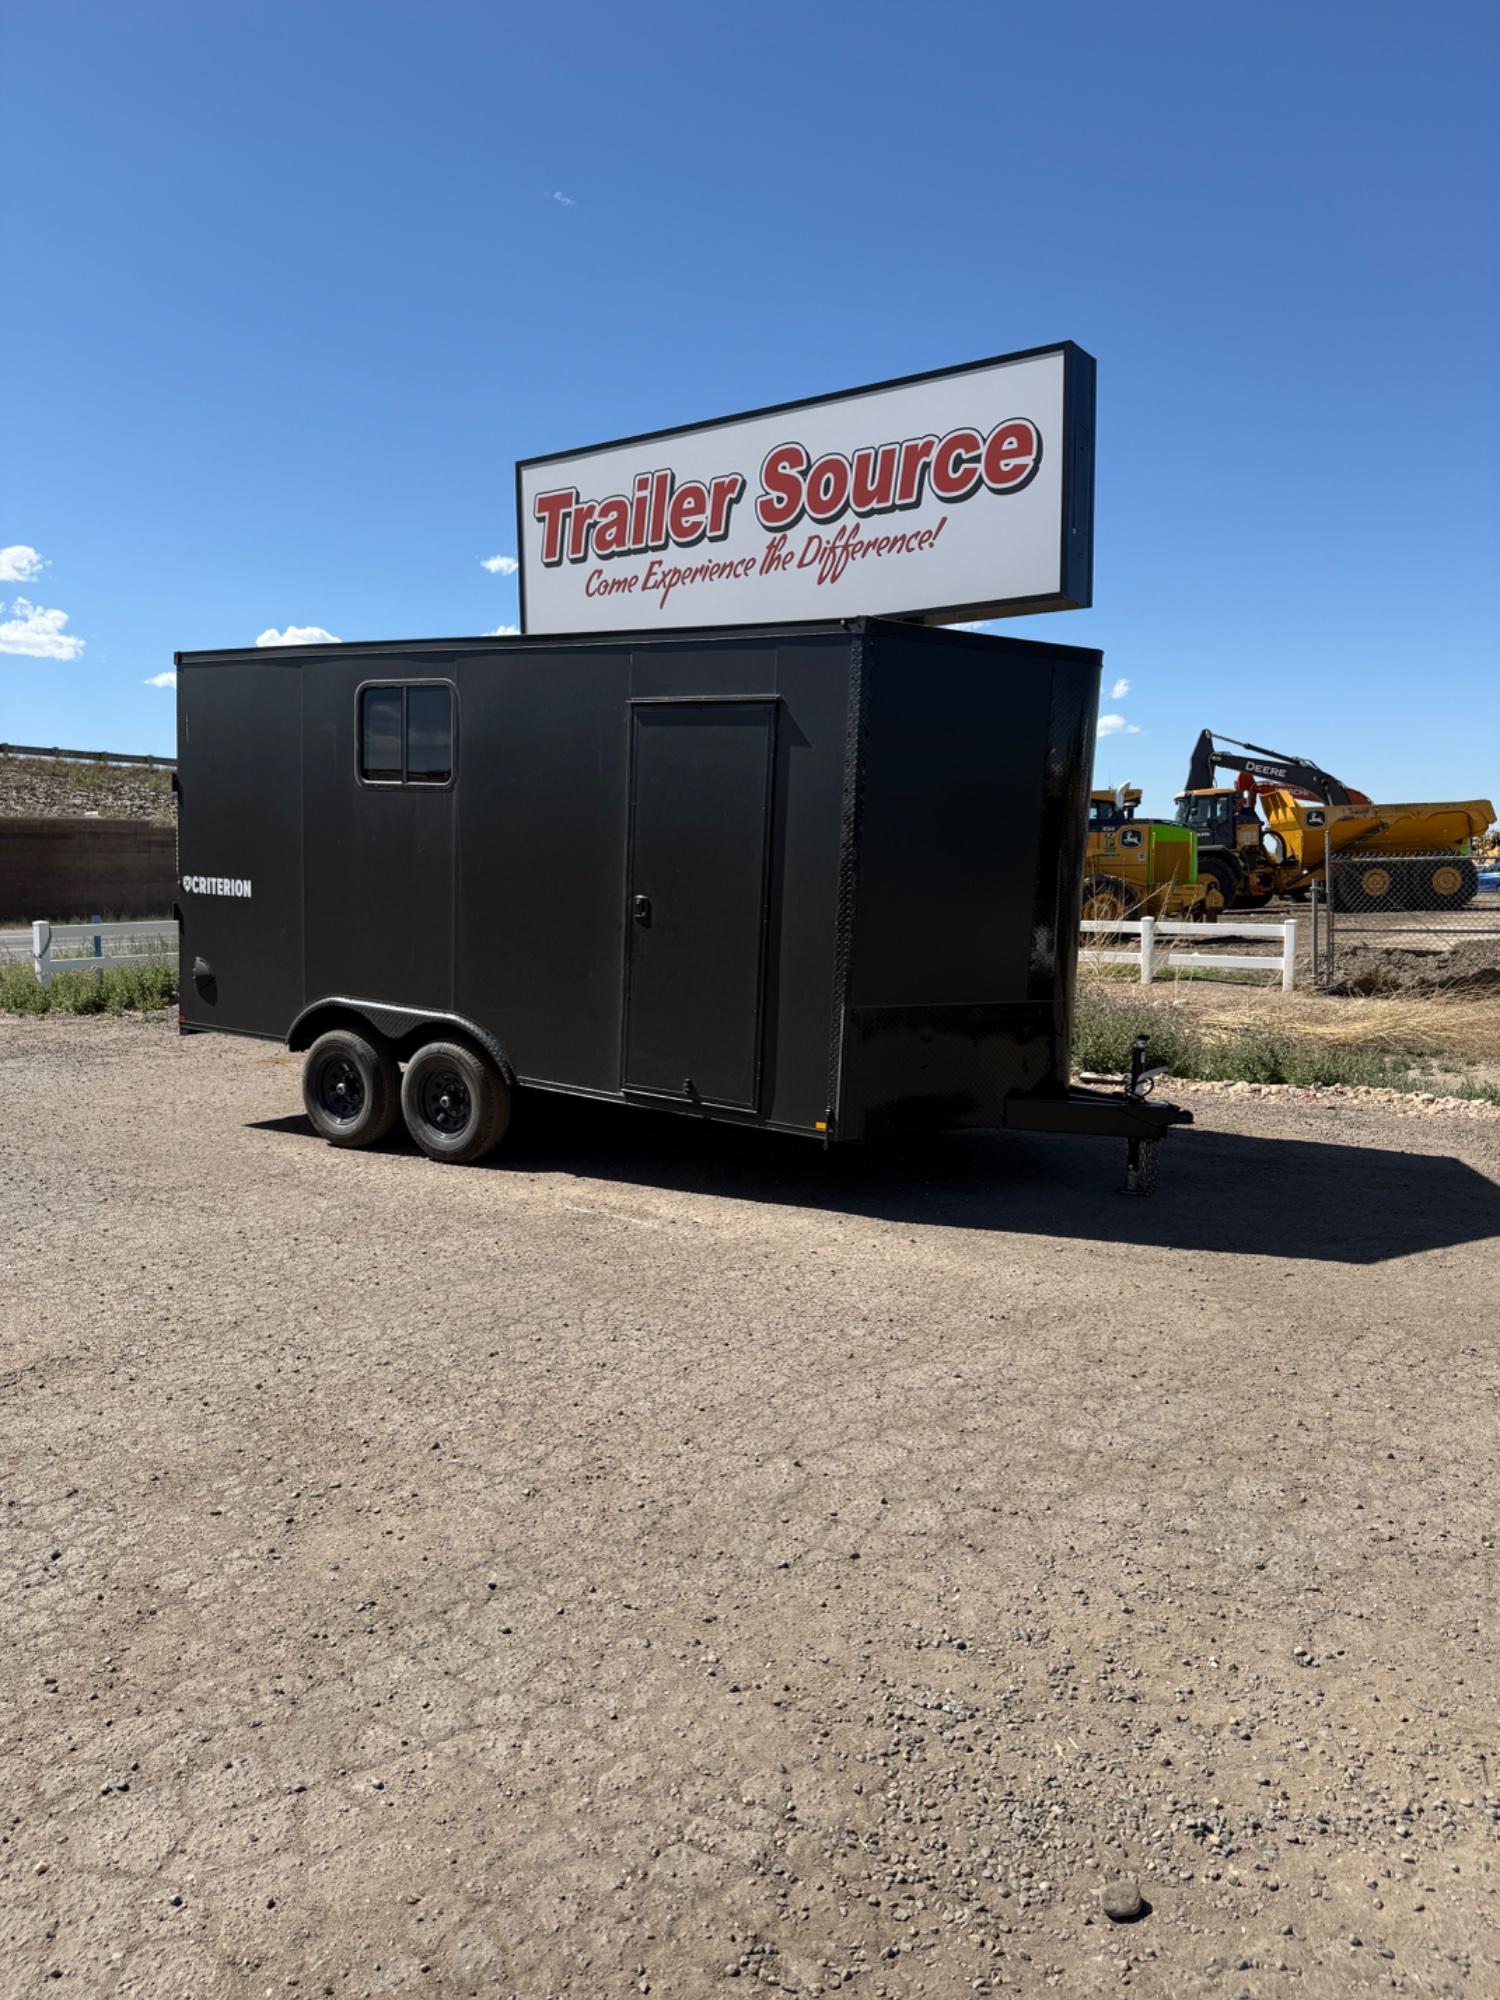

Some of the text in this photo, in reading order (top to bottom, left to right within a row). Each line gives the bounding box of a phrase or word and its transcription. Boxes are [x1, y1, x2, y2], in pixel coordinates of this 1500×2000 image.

[534, 417, 1043, 568] Trailer Source
[585, 516, 948, 609] Come Experience the Difference!
[1245, 761, 1287, 778] DEERE
[192, 876, 252, 898] CRITERION
